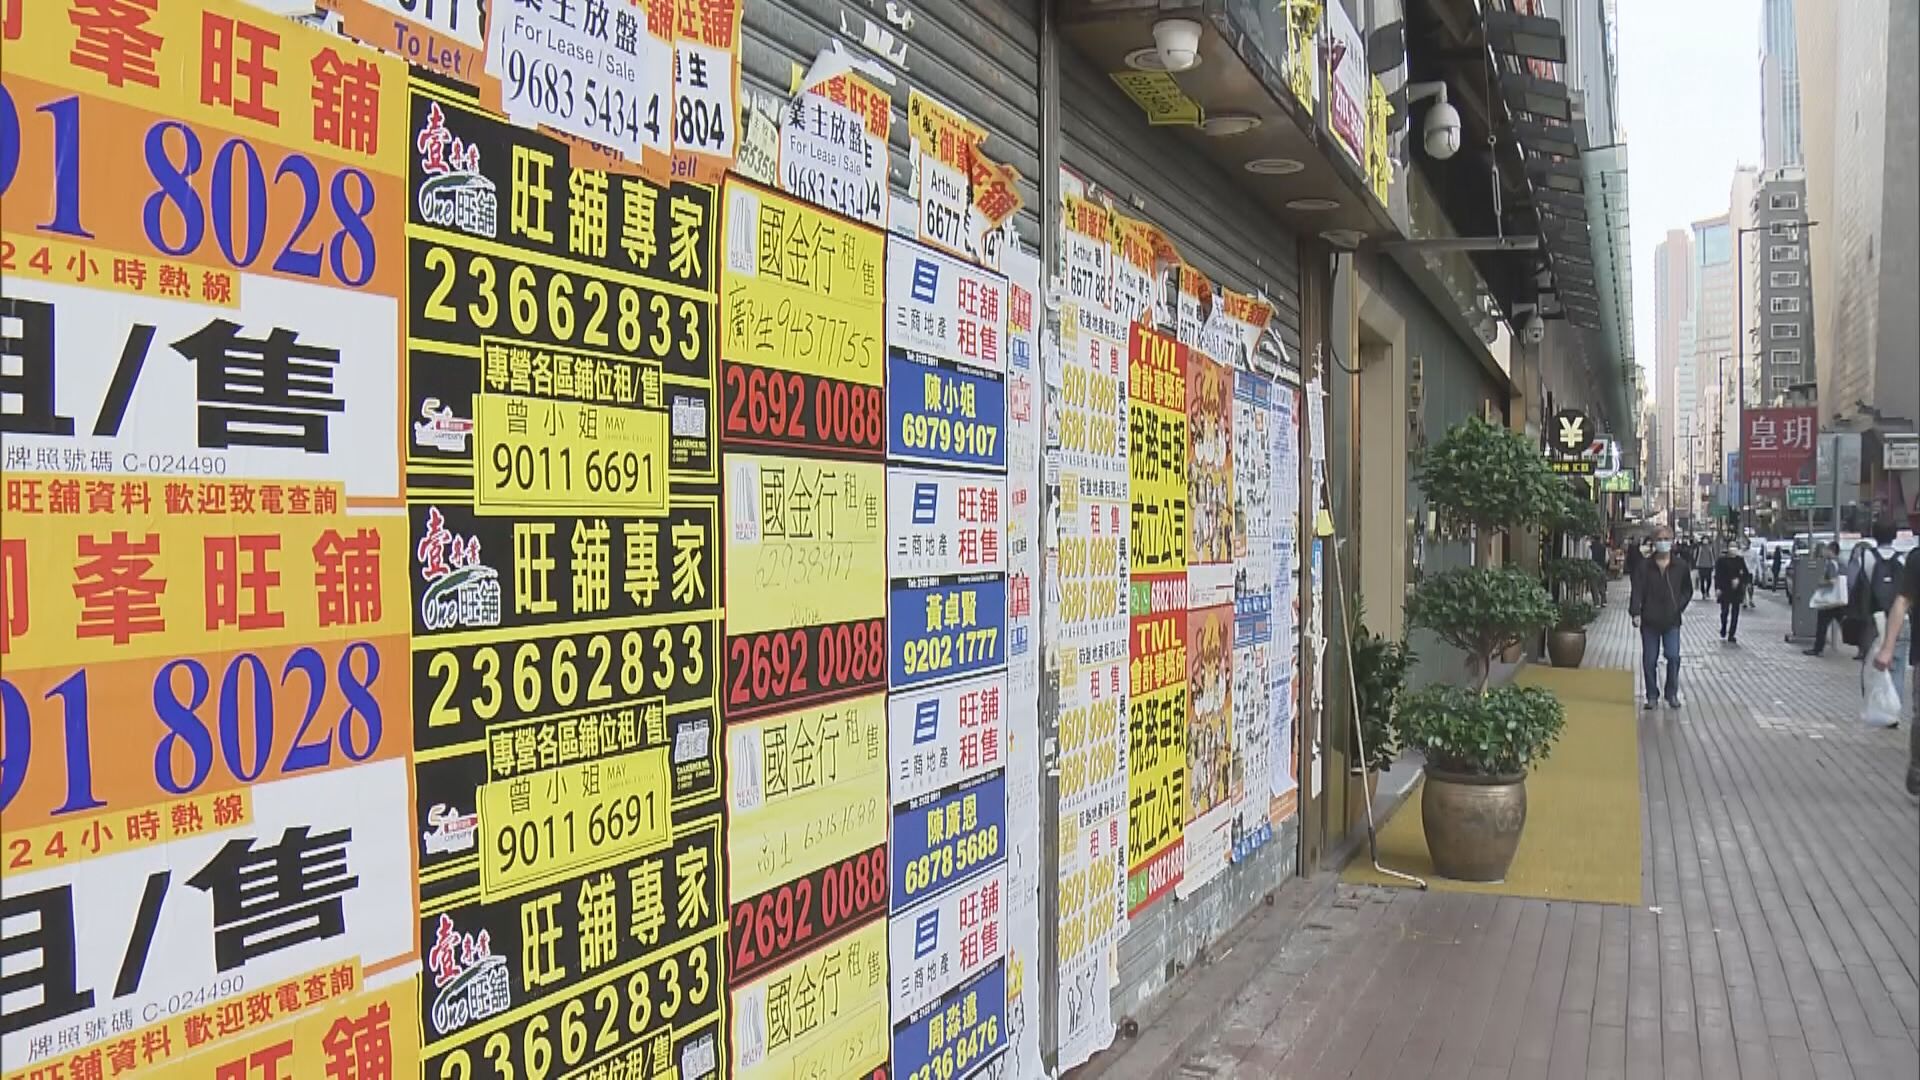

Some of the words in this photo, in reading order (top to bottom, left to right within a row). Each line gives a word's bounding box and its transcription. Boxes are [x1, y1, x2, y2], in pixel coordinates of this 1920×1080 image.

[394, 22, 420, 57] To
[428, 37, 461, 74] Let
[514, 15, 542, 43] For
[547, 28, 594, 65] Lease
[606, 54, 635, 82] Sale
[2, 0, 382, 157] 峯旺舖
[508, 49, 574, 119] 9683
[583, 78, 639, 143] 5434
[674, 95, 725, 150] 804
[788, 98, 863, 154] 業主放盤
[788, 161, 825, 204] 9683
[790, 135, 807, 154] For
[810, 143, 837, 167] Lease
[844, 157, 862, 177] Sale
[142, 120, 376, 287] 8028
[511, 144, 704, 280] 旺舖專家
[930, 169, 961, 206] Arthur
[926, 198, 961, 247] 6677
[758, 202, 836, 295] 國金行
[840, 231, 876, 297] 租/售
[424, 247, 701, 362] 23662833
[957, 277, 998, 325] 旺舖
[1071, 265, 1093, 299] 6677
[957, 319, 998, 363] 租售
[1138, 328, 1180, 375] TML
[727, 365, 806, 438] 2692
[815, 380, 881, 445] 0088
[923, 373, 976, 418] 陳小姐
[1130, 360, 1186, 410] 會計事務所
[507, 399, 598, 440] 曾小姐
[604, 416, 626, 431] MAY
[902, 414, 949, 452] 6979
[954, 421, 997, 457] 9107
[1749, 414, 1813, 451] 皇玥
[5, 446, 114, 473] 牌照號碼
[122, 453, 227, 475] C-024490
[492, 442, 571, 492] 9011
[585, 451, 652, 494] 6691
[7, 479, 152, 515] 旺舖資料
[164, 482, 338, 517] 歡迎致電查詢
[761, 466, 838, 540] 國金行
[844, 471, 878, 531] 租/售
[957, 487, 998, 524] 旺舖
[958, 528, 998, 565] 租售
[1131, 492, 1186, 568] 成立公司
[513, 519, 705, 614] 旺舖專家
[730, 630, 808, 705] 2692
[818, 620, 883, 687] 0088
[903, 636, 952, 675] 9202
[956, 628, 998, 664] 1777
[1137, 617, 1182, 655] TML
[428, 625, 704, 727] 23662833
[1130, 645, 1187, 696] 會計事務所
[152, 641, 384, 795] 8028
[959, 687, 999, 729] 旺舖
[763, 711, 840, 801] 國金行
[845, 708, 880, 762] 租/售
[959, 728, 999, 771] 租售
[510, 765, 600, 816] 曾小姐
[607, 763, 627, 779] MAY
[8, 794, 245, 870] 24小時熱線
[498, 810, 576, 873] 9011
[588, 791, 655, 847] 6691
[1128, 767, 1185, 866] 成立公司
[905, 848, 953, 894] 6878
[955, 825, 998, 872] 5688
[521, 846, 710, 992] 旺舖專家
[735, 877, 813, 968] 2692
[821, 847, 886, 926] 0088
[959, 880, 999, 931] 旺舖
[959, 922, 998, 972] 租售
[28, 1009, 134, 1063] 牌照號碼
[142, 974, 245, 1022] C-024490
[184, 965, 355, 1048] 歡迎致電查詢
[767, 951, 841, 1055] 國金行
[956, 1015, 998, 1069] 8476
